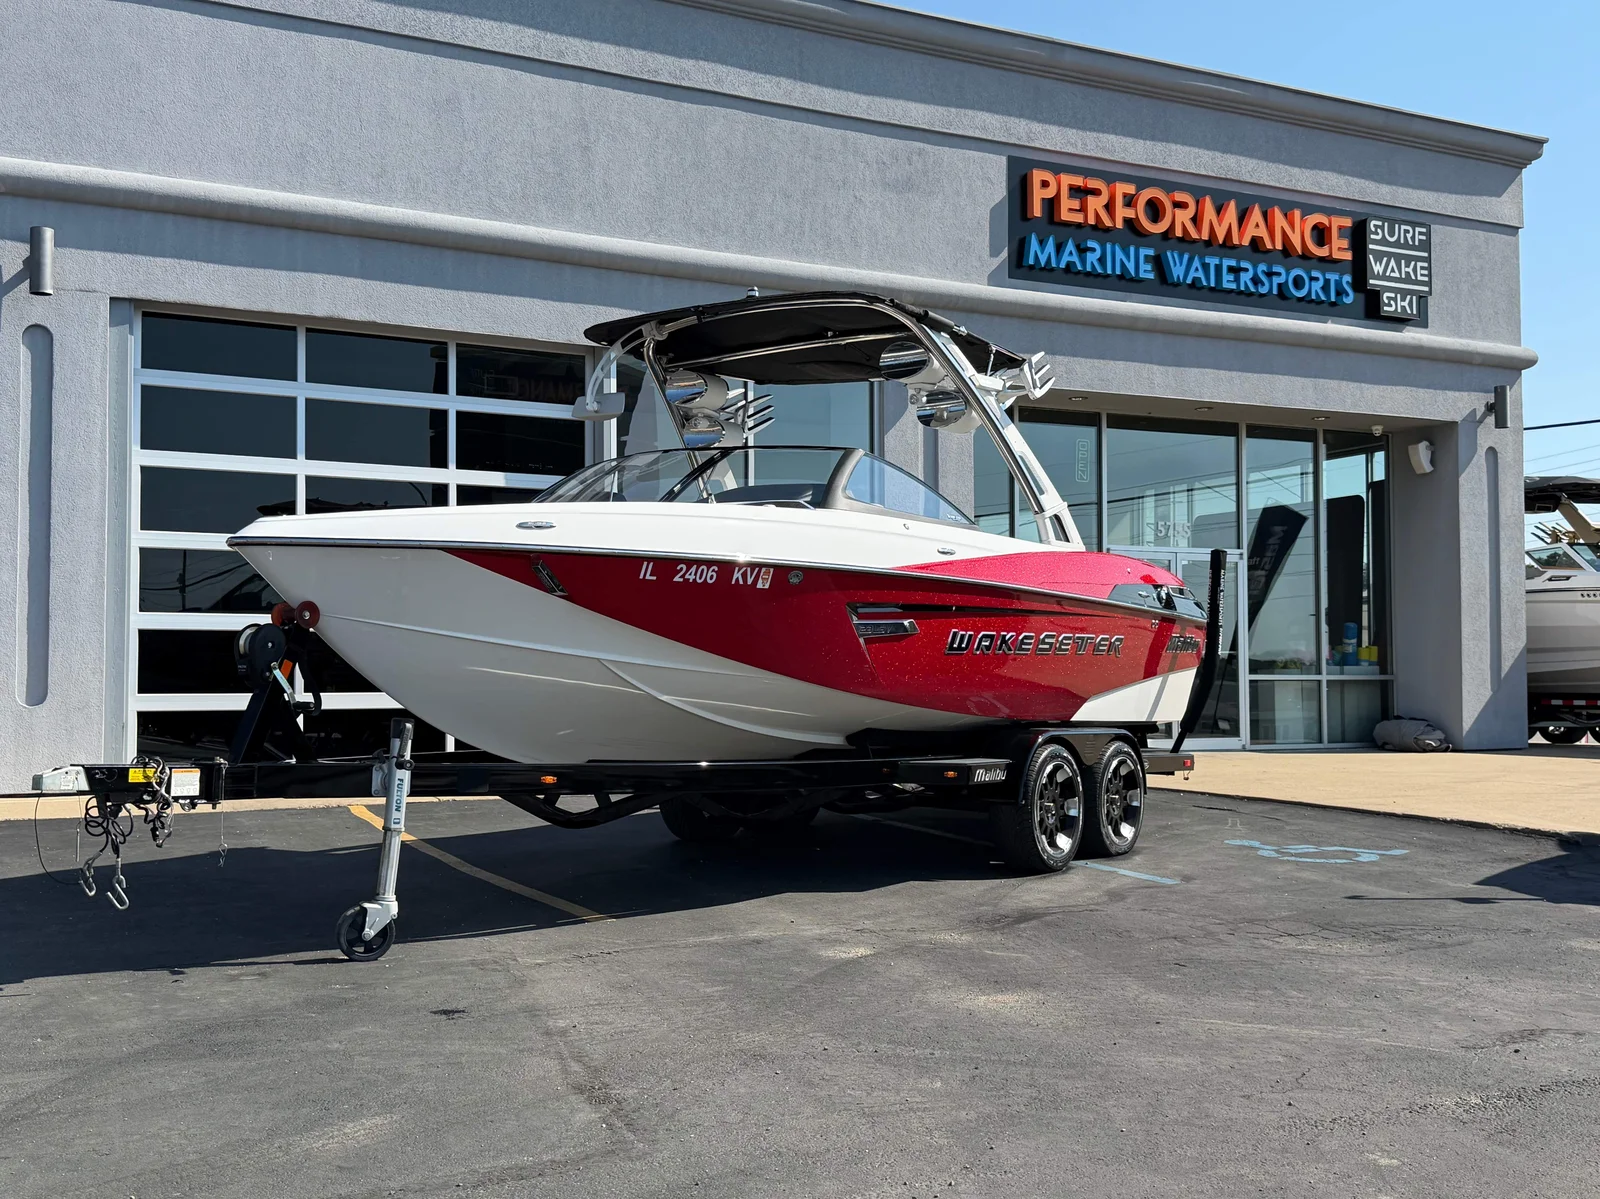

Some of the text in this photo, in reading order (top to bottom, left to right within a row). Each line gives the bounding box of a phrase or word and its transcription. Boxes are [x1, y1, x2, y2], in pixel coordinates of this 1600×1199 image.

[1027, 168, 1353, 261] PERFORMANCE
[1370, 219, 1428, 247] SURF
[1023, 232, 1354, 305] MARINE WATERSPORTS
[1369, 254, 1429, 282] WAKE
[1382, 291, 1418, 315] SKI
[1078, 441, 1088, 480] OPEN
[639, 561, 657, 581] IL
[673, 563, 718, 584] 2406
[731, 566, 759, 585] KV
[974, 768, 1007, 782] Malibu
[394, 778, 404, 812] FULTON
